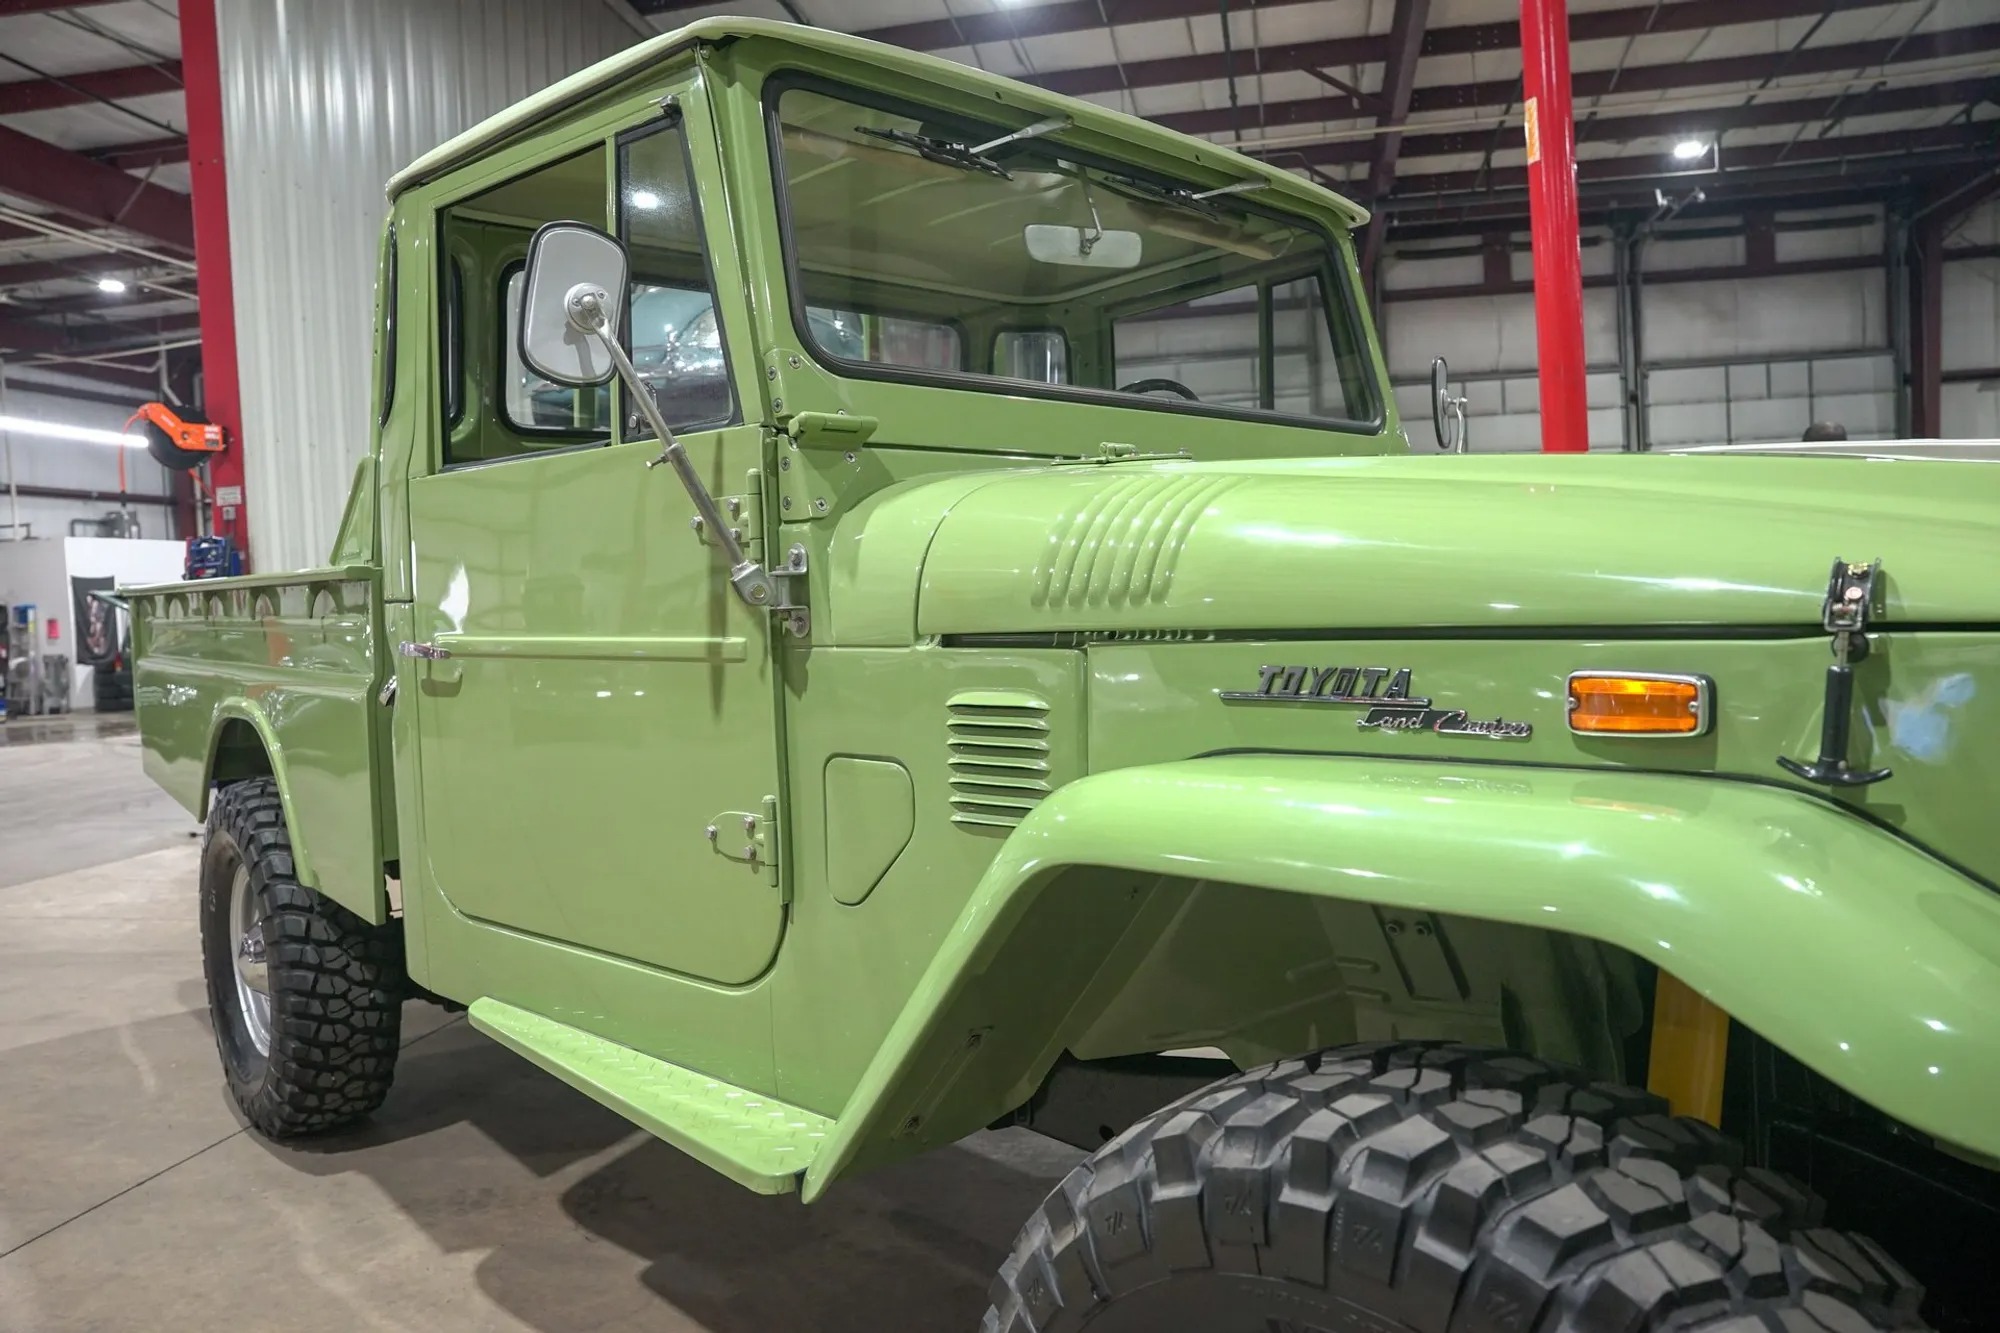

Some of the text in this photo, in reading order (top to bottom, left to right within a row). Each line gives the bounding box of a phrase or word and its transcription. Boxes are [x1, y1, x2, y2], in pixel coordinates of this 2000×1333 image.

[1257, 665, 1411, 699] TOYOTA
[1356, 707, 1533, 738] Land Cruiser
